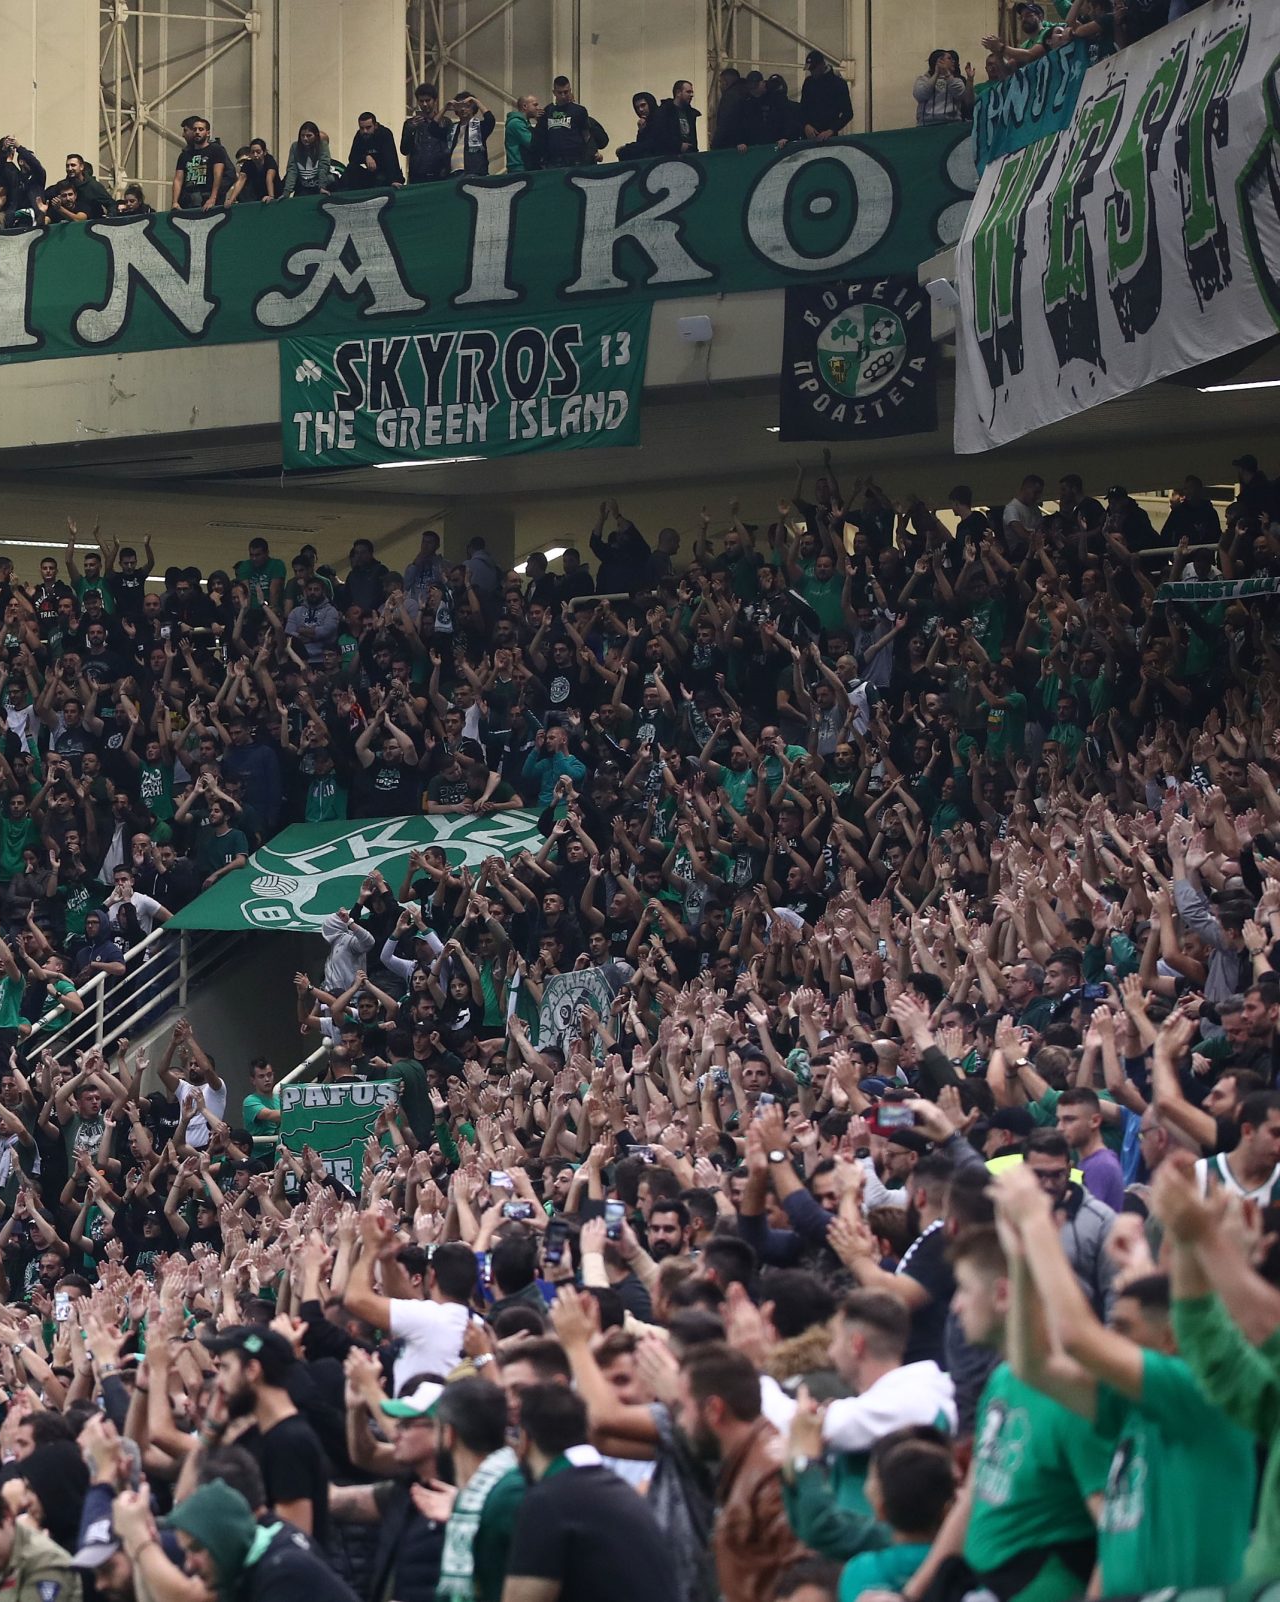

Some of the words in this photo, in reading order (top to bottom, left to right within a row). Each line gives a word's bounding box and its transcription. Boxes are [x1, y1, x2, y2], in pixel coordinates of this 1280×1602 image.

[973, 18, 1251, 355] WEST
[333, 323, 584, 412] SKYROS
[600, 331, 631, 368] 13
[293, 410, 357, 455] THE
[376, 401, 489, 451] GREEN
[509, 390, 629, 441] ISLAND
